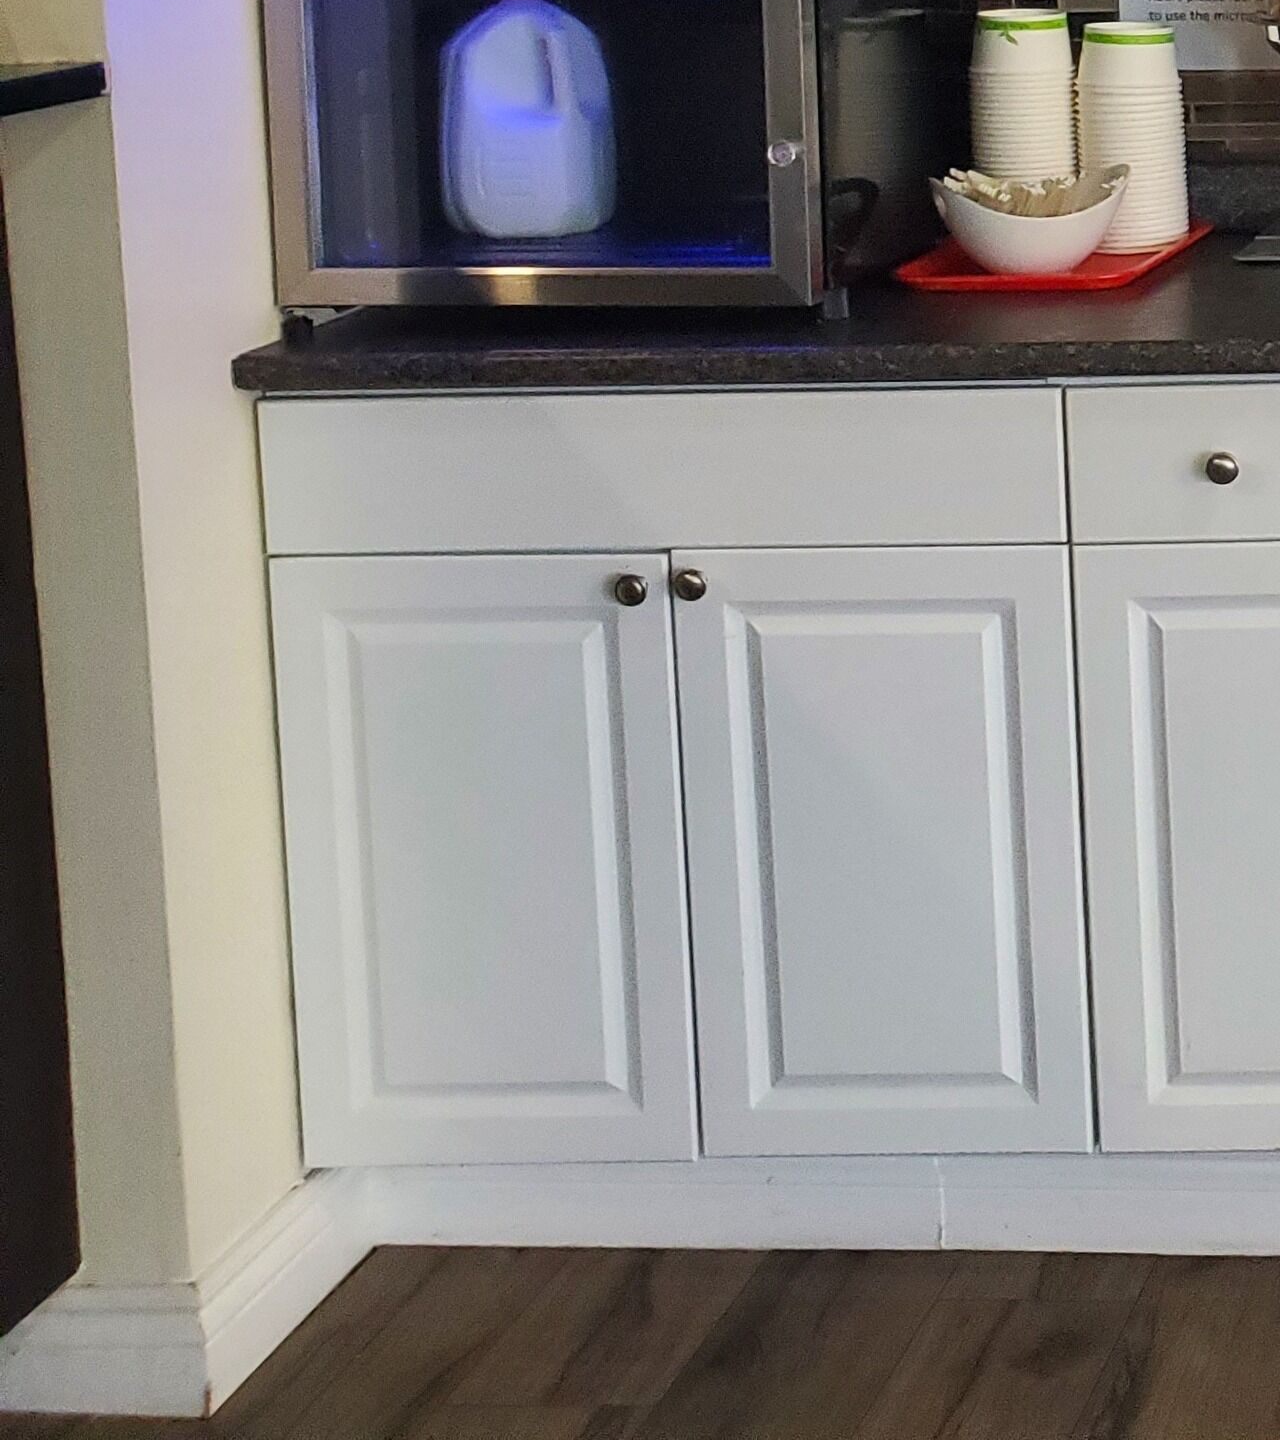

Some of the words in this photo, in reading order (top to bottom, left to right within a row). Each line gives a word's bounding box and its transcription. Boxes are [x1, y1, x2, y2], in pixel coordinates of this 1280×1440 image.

[1148, 11, 1162, 21] to
[1165, 12, 1186, 21] use
[1190, 11, 1210, 21] the
